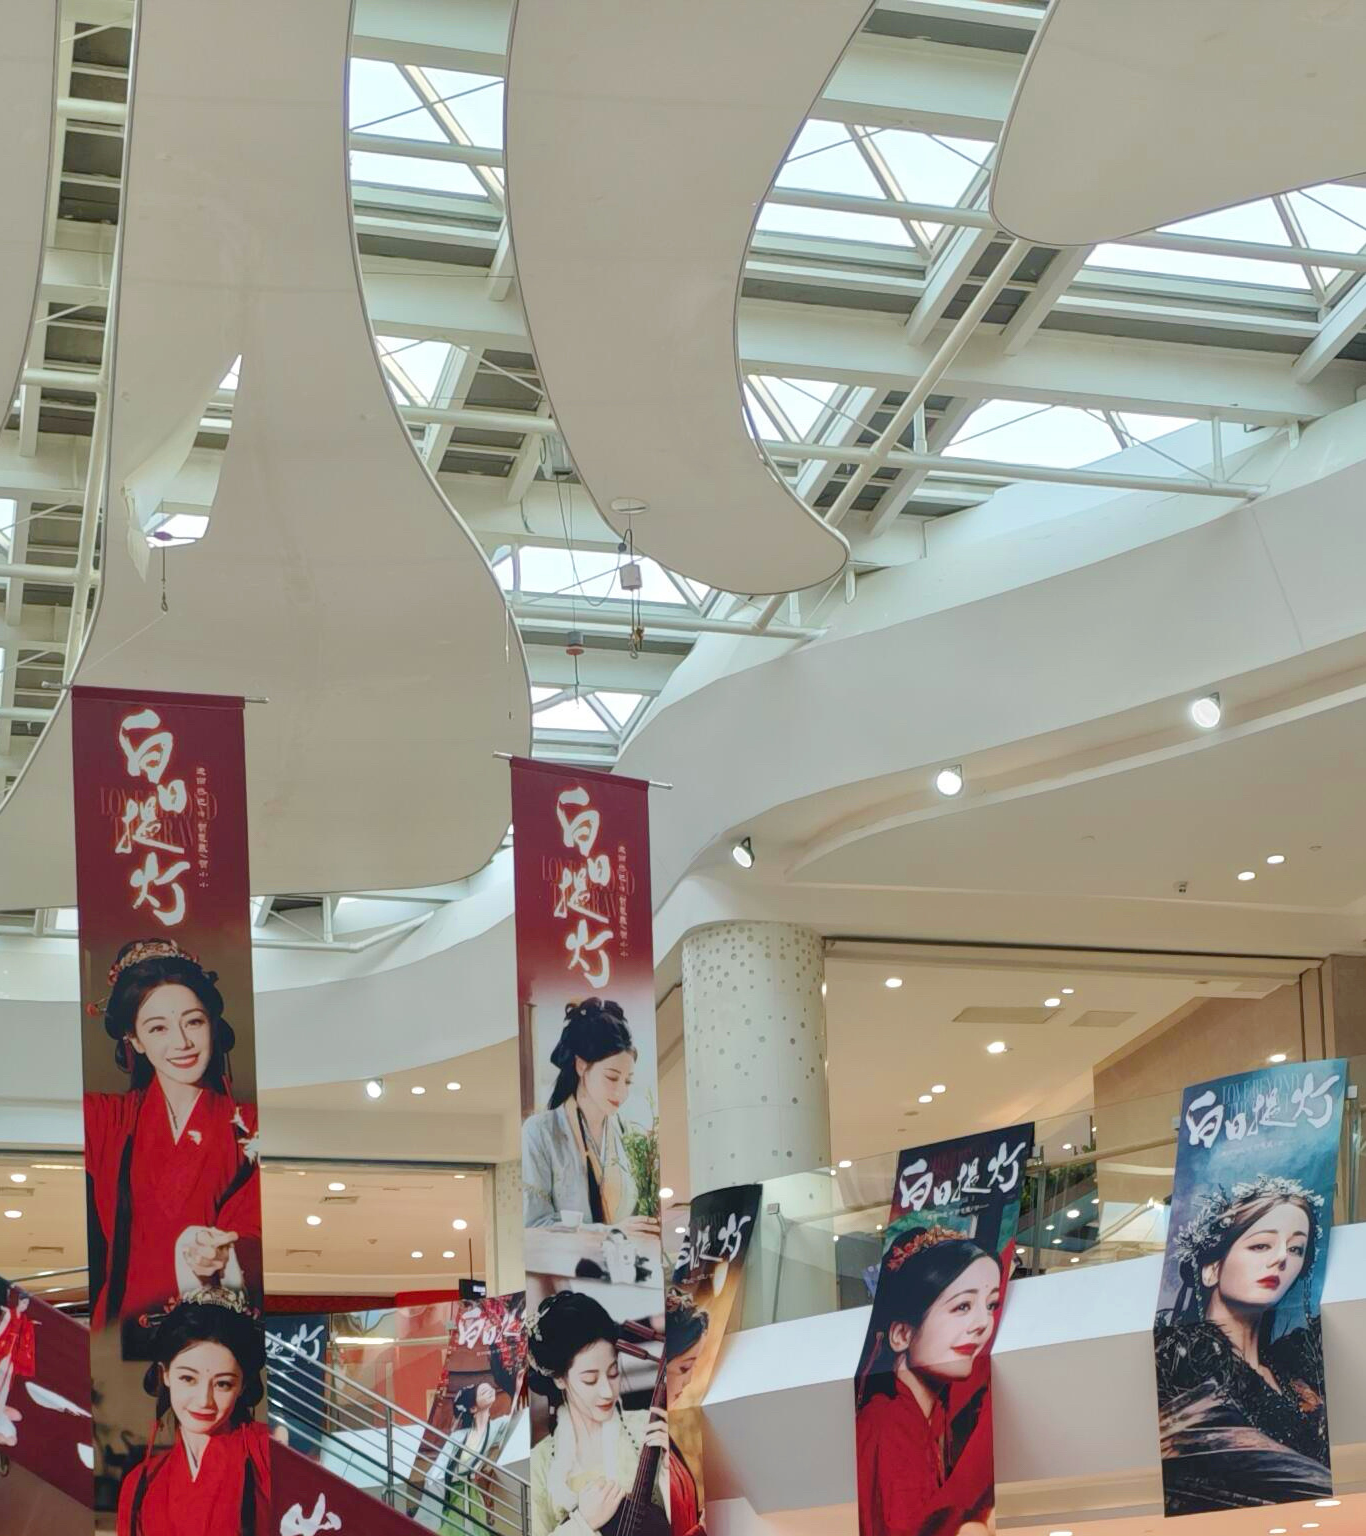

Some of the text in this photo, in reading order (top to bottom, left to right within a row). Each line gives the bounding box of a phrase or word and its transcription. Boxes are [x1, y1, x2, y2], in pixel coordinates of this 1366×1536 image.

[118, 708, 191, 926] 白日提灯
[555, 786, 614, 989] 白日提灯
[899, 1142, 1027, 1211] 白日提灯
[1186, 1073, 1340, 1148] 白日提灯
